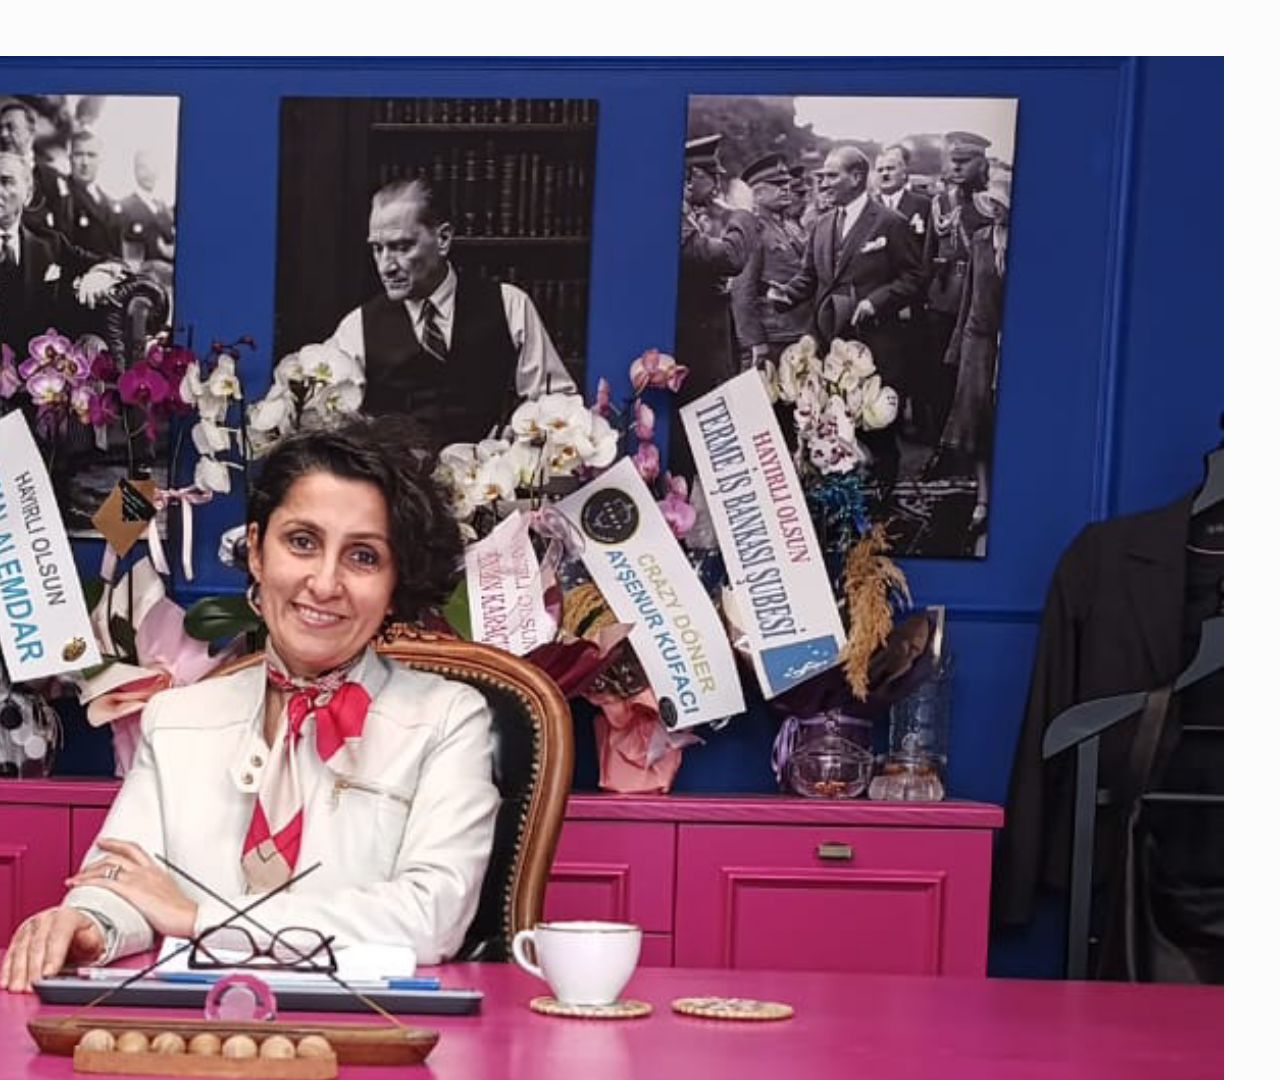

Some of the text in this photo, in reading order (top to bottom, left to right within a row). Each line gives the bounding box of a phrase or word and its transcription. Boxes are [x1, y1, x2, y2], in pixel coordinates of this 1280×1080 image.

[14, 470, 67, 607] HAYIRLI OLSUN
[696, 397, 808, 641] TERME İŞ BANKASI ŞUBESİ
[752, 431, 811, 564] HAYIRLI OLSUN
[605, 550, 701, 714] AYŞENUR KUFACI
[638, 553, 719, 695] CRAZY DÖNER
